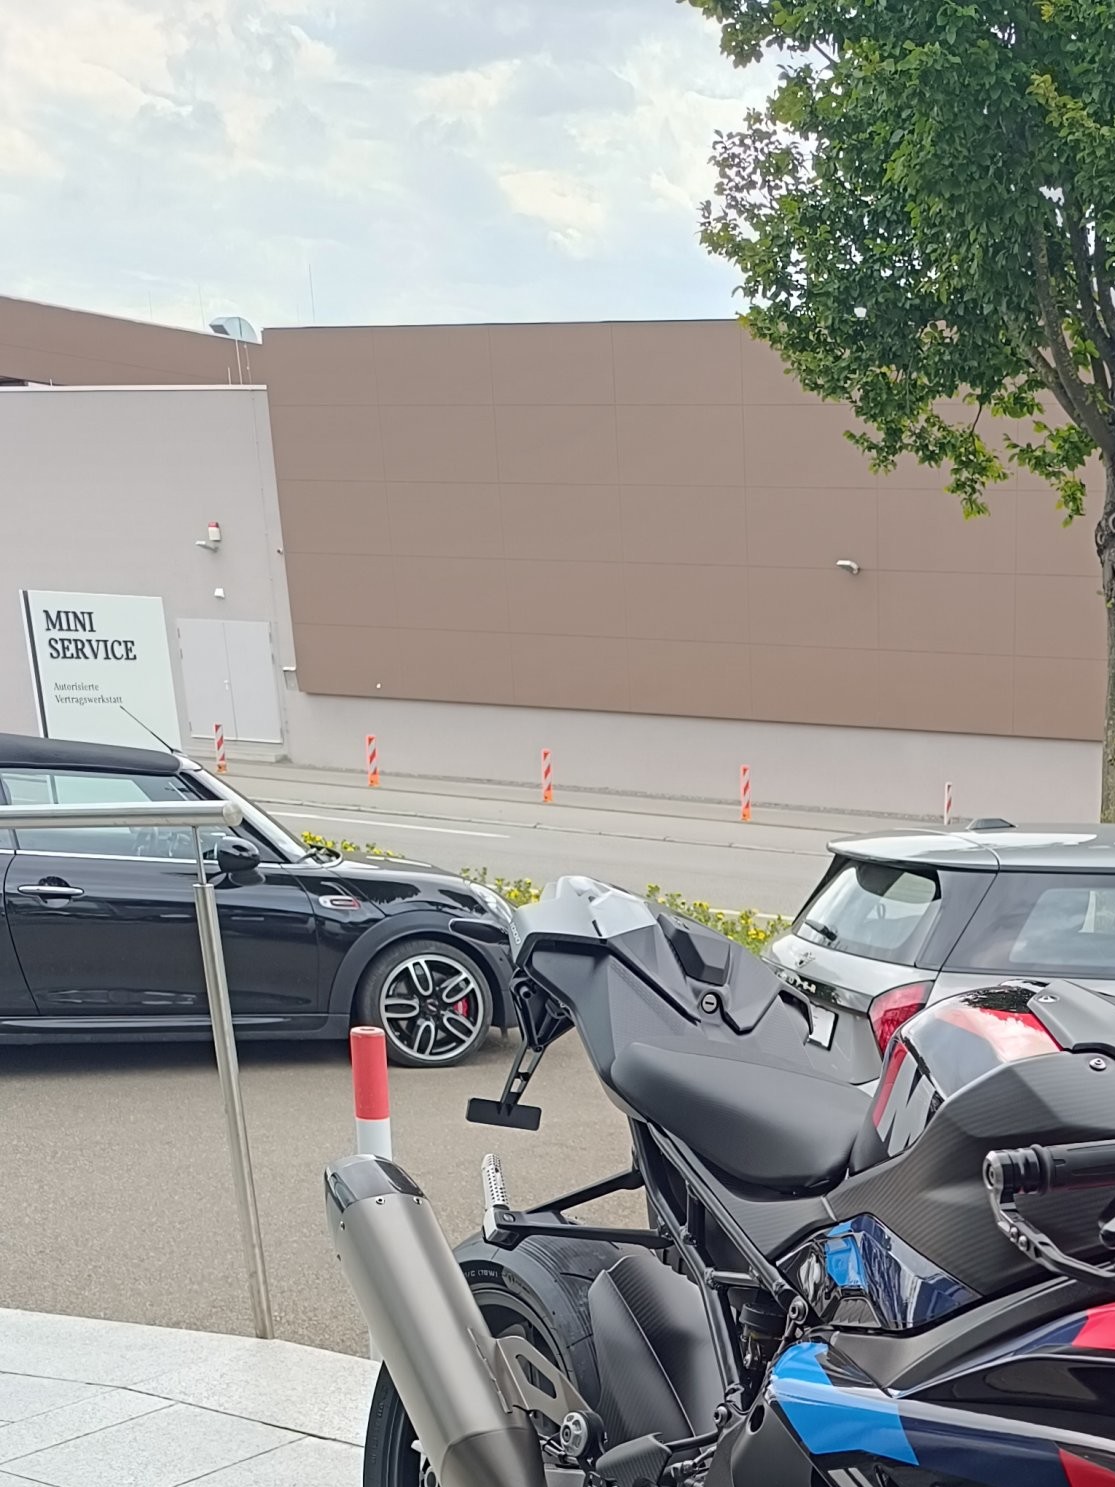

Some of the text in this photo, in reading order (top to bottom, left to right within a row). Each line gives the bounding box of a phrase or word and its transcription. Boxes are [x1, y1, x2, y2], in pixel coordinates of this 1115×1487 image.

[42, 609, 97, 633] MINI
[48, 638, 137, 660] SERVICE
[53, 682, 100, 692] Autorisierte
[54, 694, 123, 706] Vertragswerkstatt
